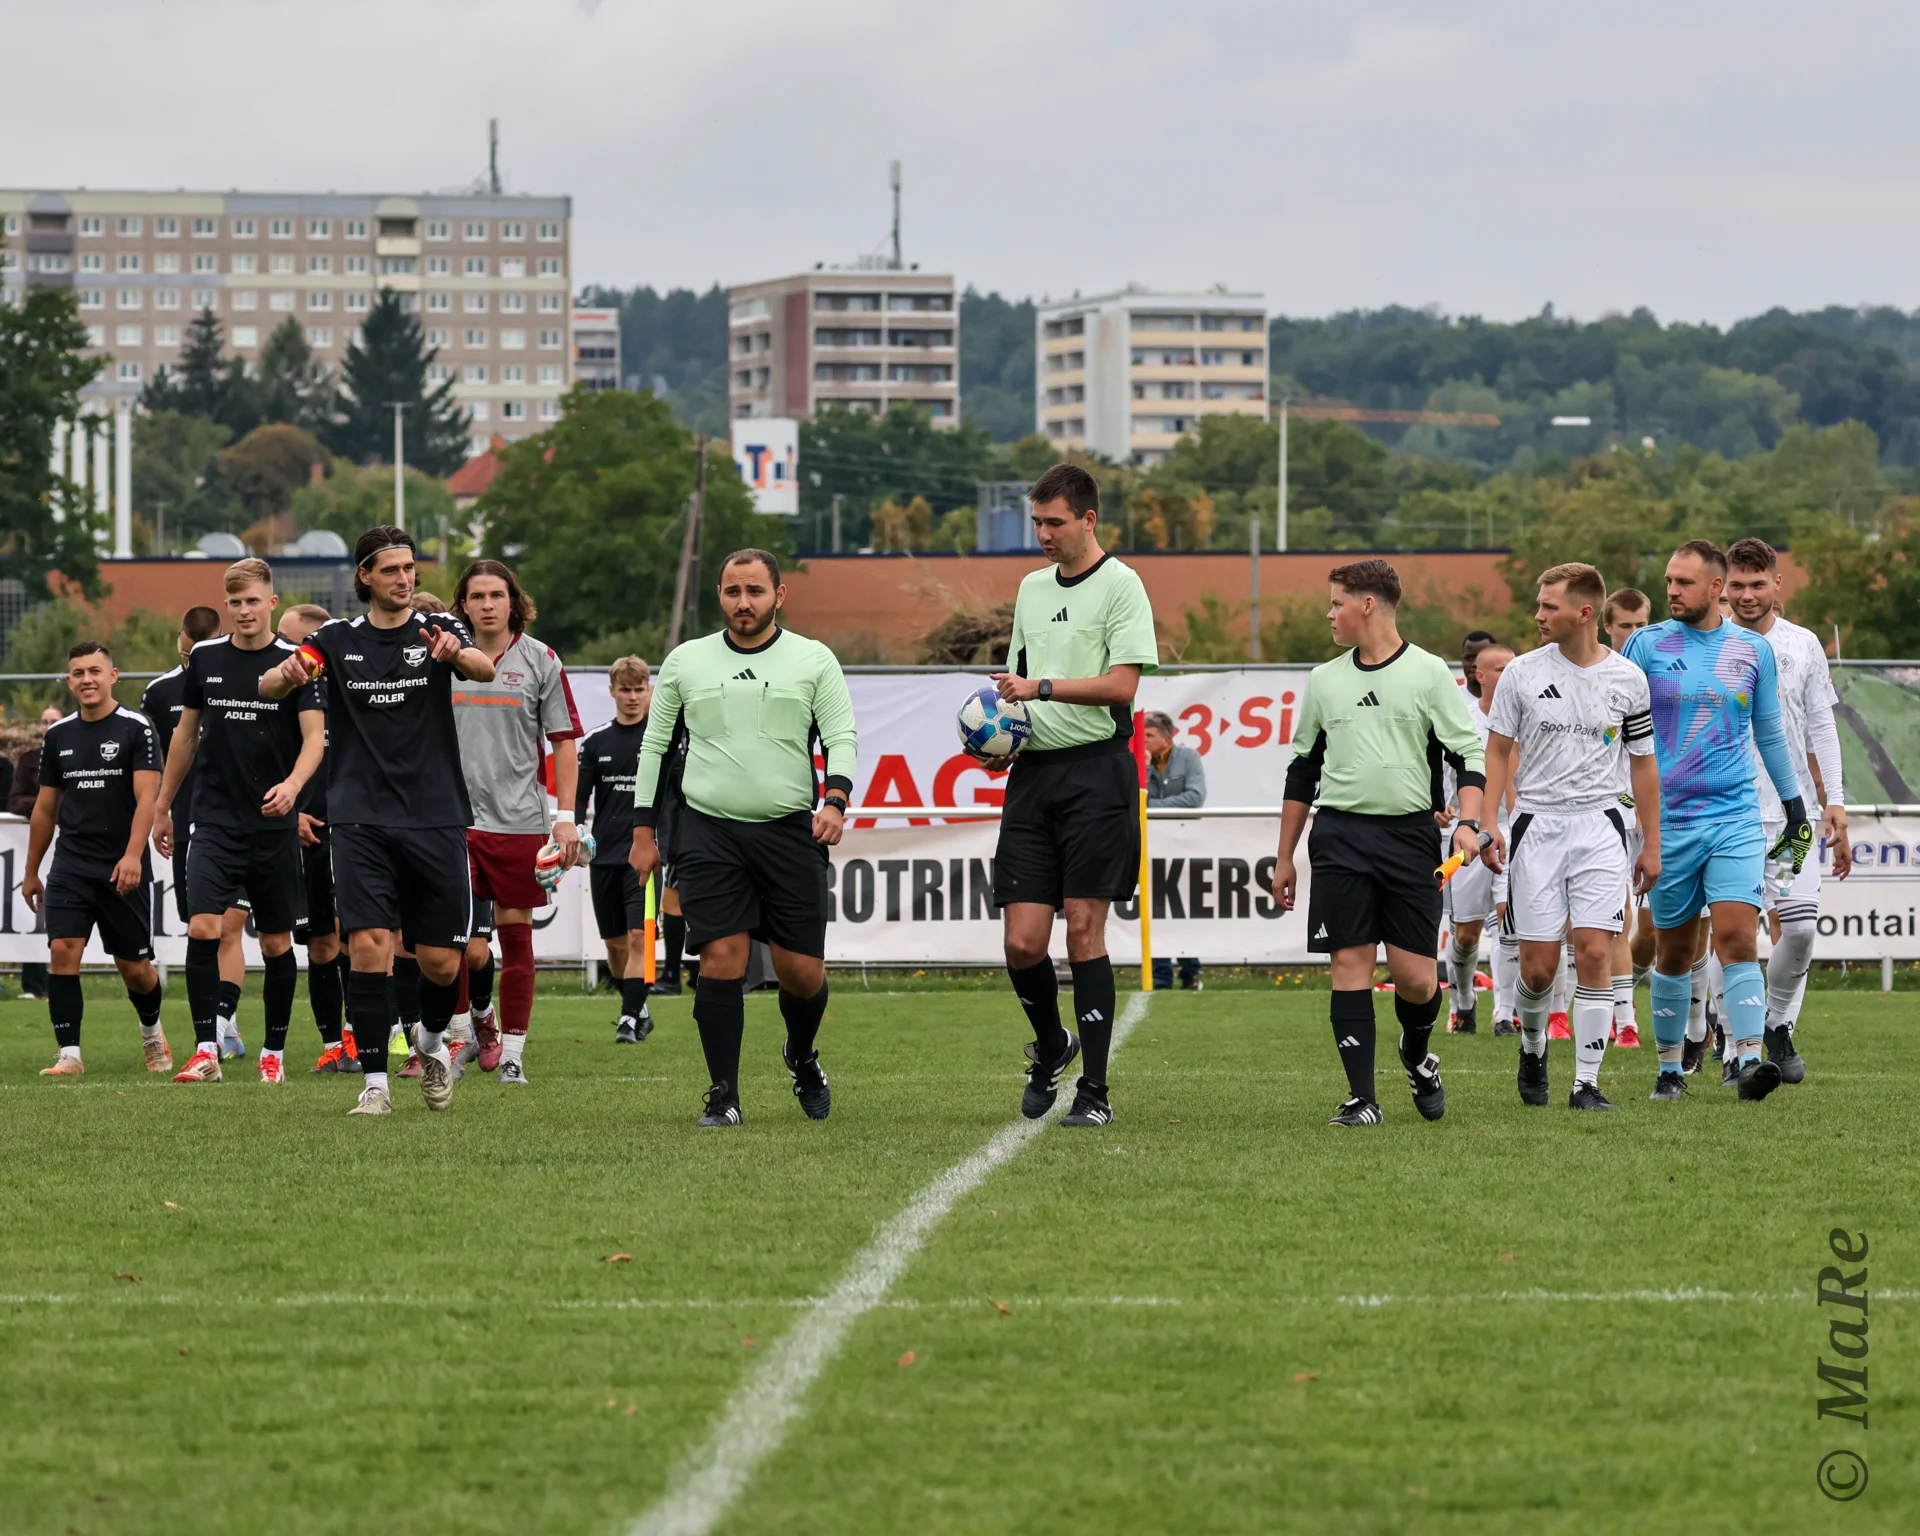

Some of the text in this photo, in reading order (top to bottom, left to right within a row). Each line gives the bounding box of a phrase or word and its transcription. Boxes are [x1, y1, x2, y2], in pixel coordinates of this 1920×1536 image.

[344, 654, 364, 662] JAKO
[347, 677, 428, 690] Containerdienst
[368, 693, 405, 704] ADLER
[207, 698, 279, 711] Containerdienst
[224, 711, 257, 721] ADLER
[1540, 721, 1600, 737] Sport Park
[62, 768, 123, 779] Containerdienst
[77, 780, 105, 789] ADLER
[295, 917, 309, 926] JAKO
